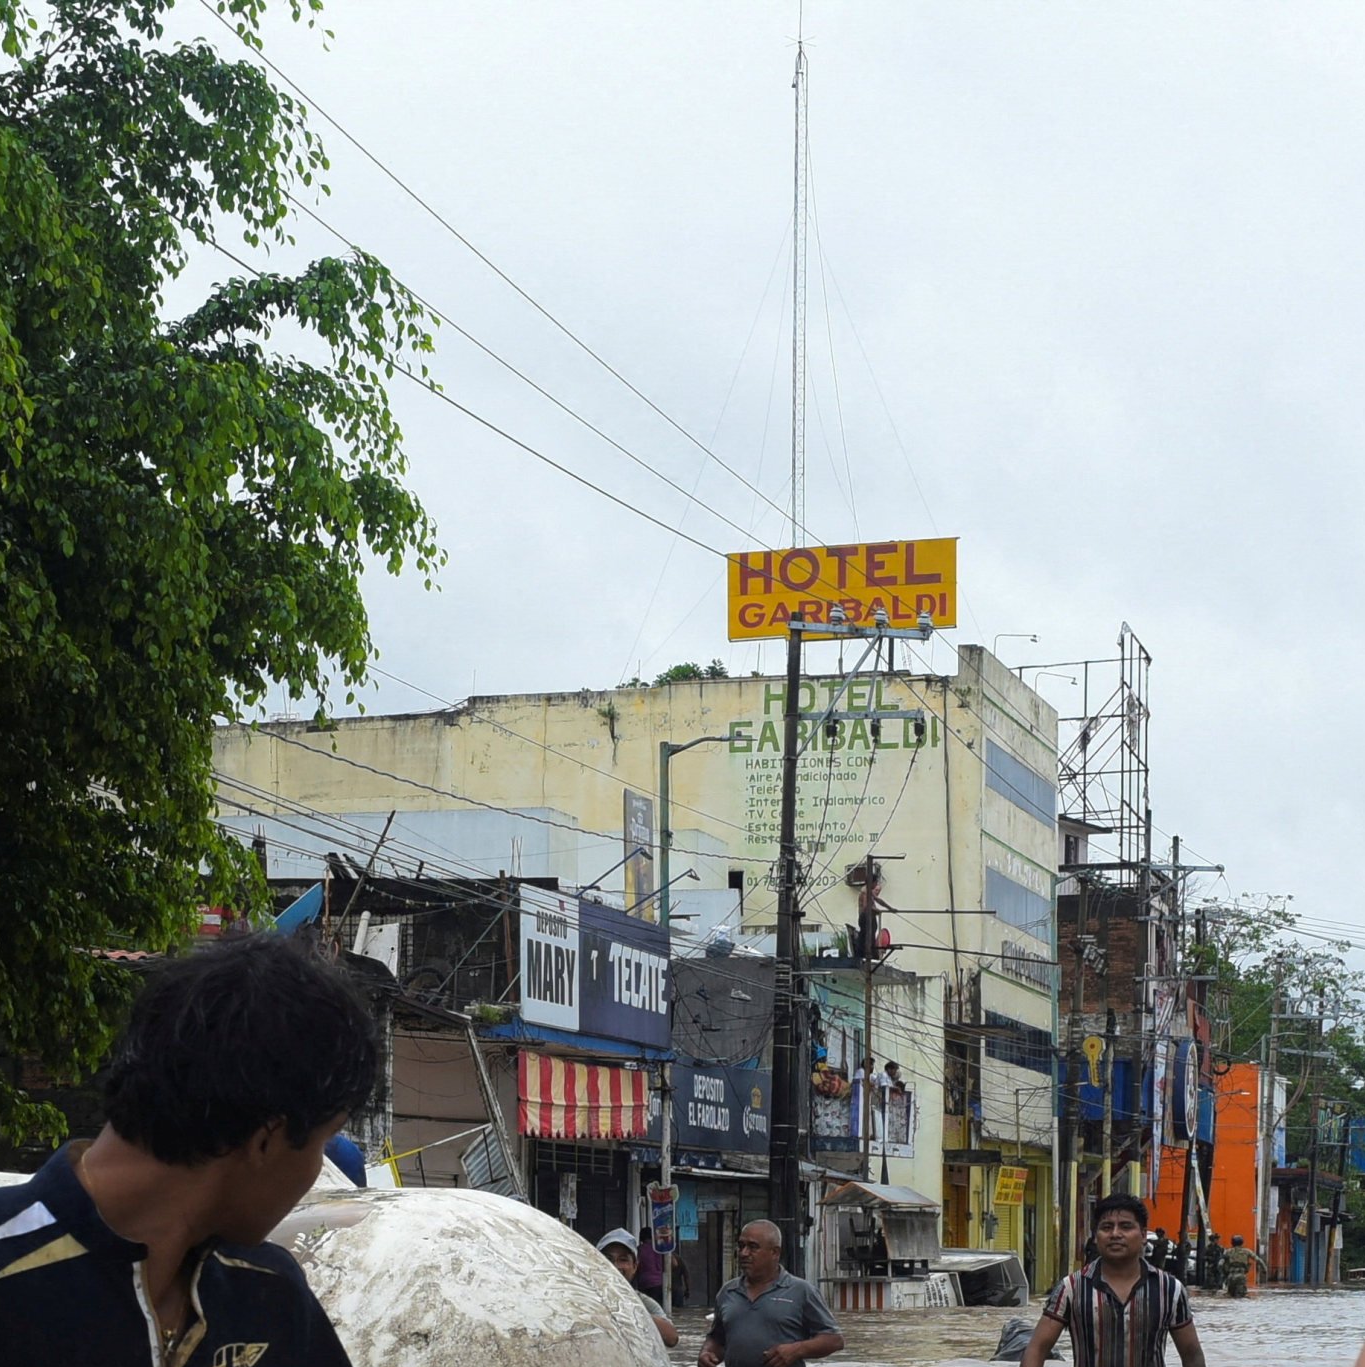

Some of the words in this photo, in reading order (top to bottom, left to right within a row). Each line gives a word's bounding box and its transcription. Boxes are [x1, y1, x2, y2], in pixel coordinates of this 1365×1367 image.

[739, 543, 942, 596] HOTEL
[738, 593, 947, 629] GARIBALDI
[764, 679, 900, 715] HOTEL
[728, 716, 940, 753] GARIBALDI
[745, 757, 841, 769] HABITIONES
[775, 771, 857, 782] Andicionado
[747, 822, 846, 833] Estacnamiento
[770, 809, 805, 820] Cle
[536, 910, 567, 940] DEPOSITO
[527, 938, 576, 1008] MARY
[608, 941, 669, 1015] TECATE
[694, 1073, 725, 1103] DEPOSITO
[688, 1101, 697, 1126] EL
[697, 1102, 730, 1132] FAROLAZO
[742, 1105, 767, 1138] Corona
